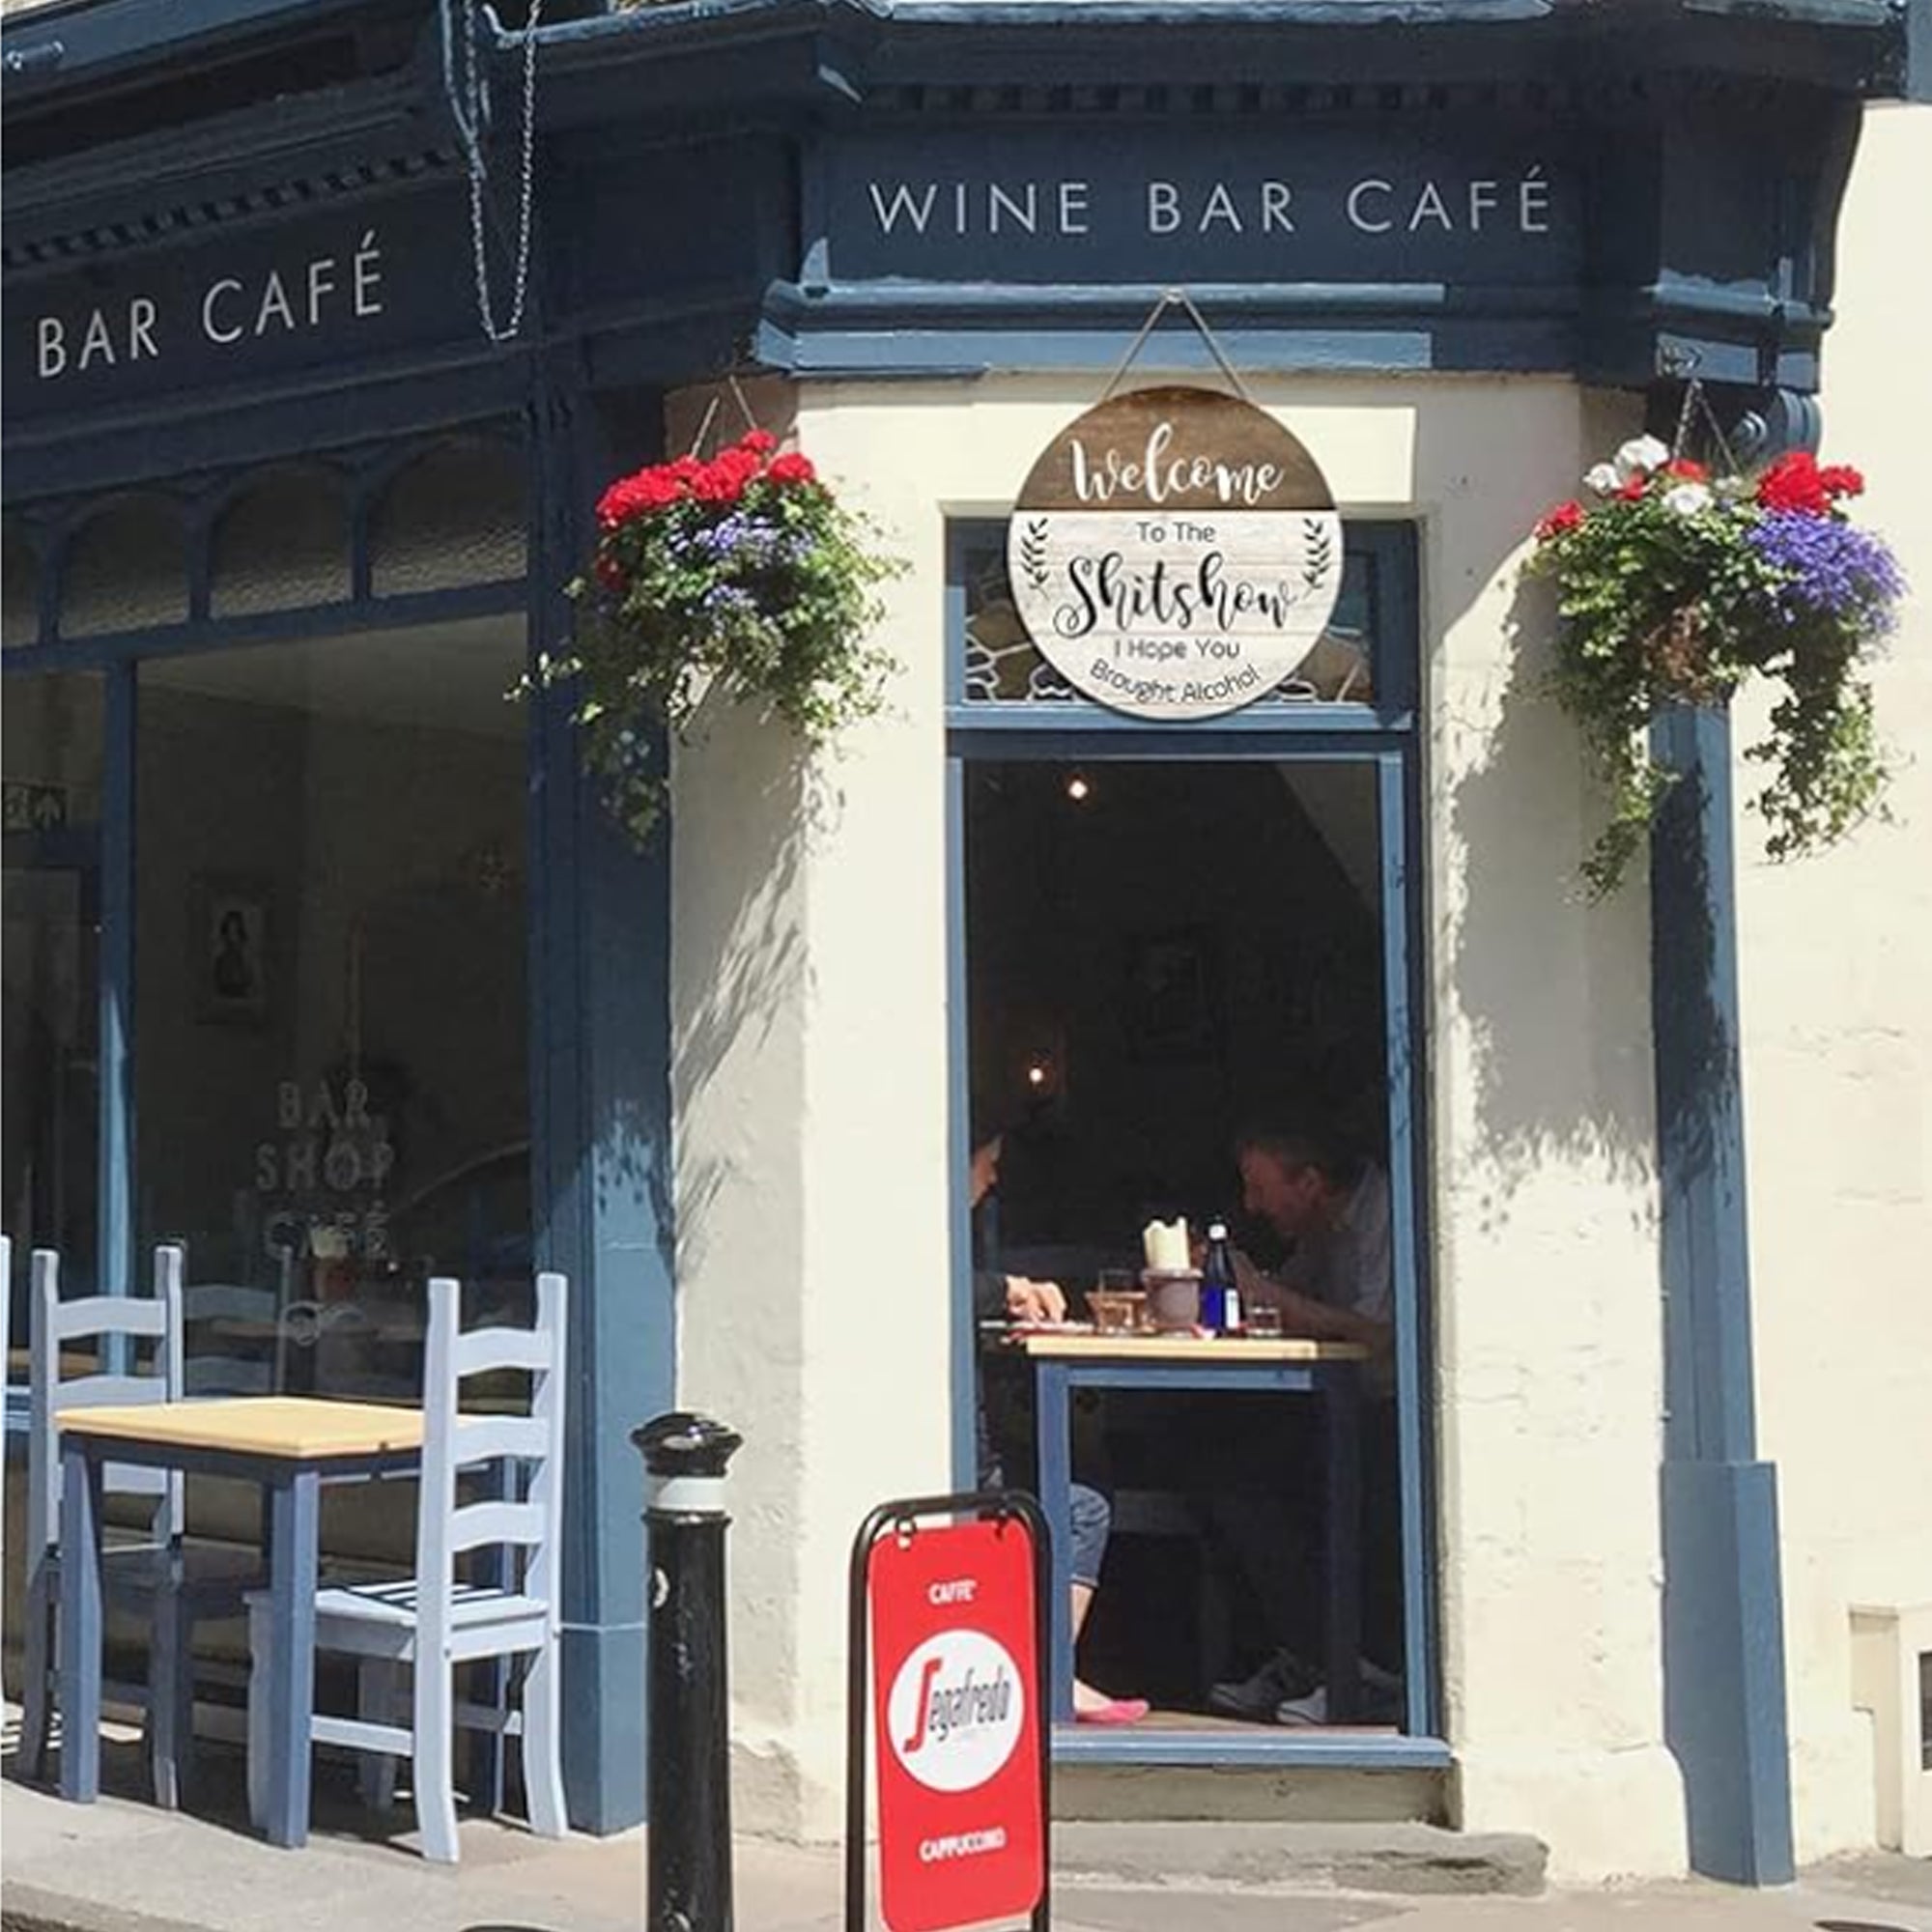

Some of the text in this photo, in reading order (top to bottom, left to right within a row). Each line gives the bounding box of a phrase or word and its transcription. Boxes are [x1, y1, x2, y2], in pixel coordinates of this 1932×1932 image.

[869, 165, 1549, 234] WINE BAR CAFÉ
[38, 229, 383, 378] BAR CAFÉ
[1070, 422, 1284, 505] Welcome
[1136, 522, 1216, 543] To The
[1052, 551, 1297, 639] Shitshow
[1114, 639, 1241, 665] I Hope You
[1090, 658, 1260, 704] Brought Alcohol
[276, 1078, 373, 1129] BAR
[255, 1140, 395, 1191] SHOP
